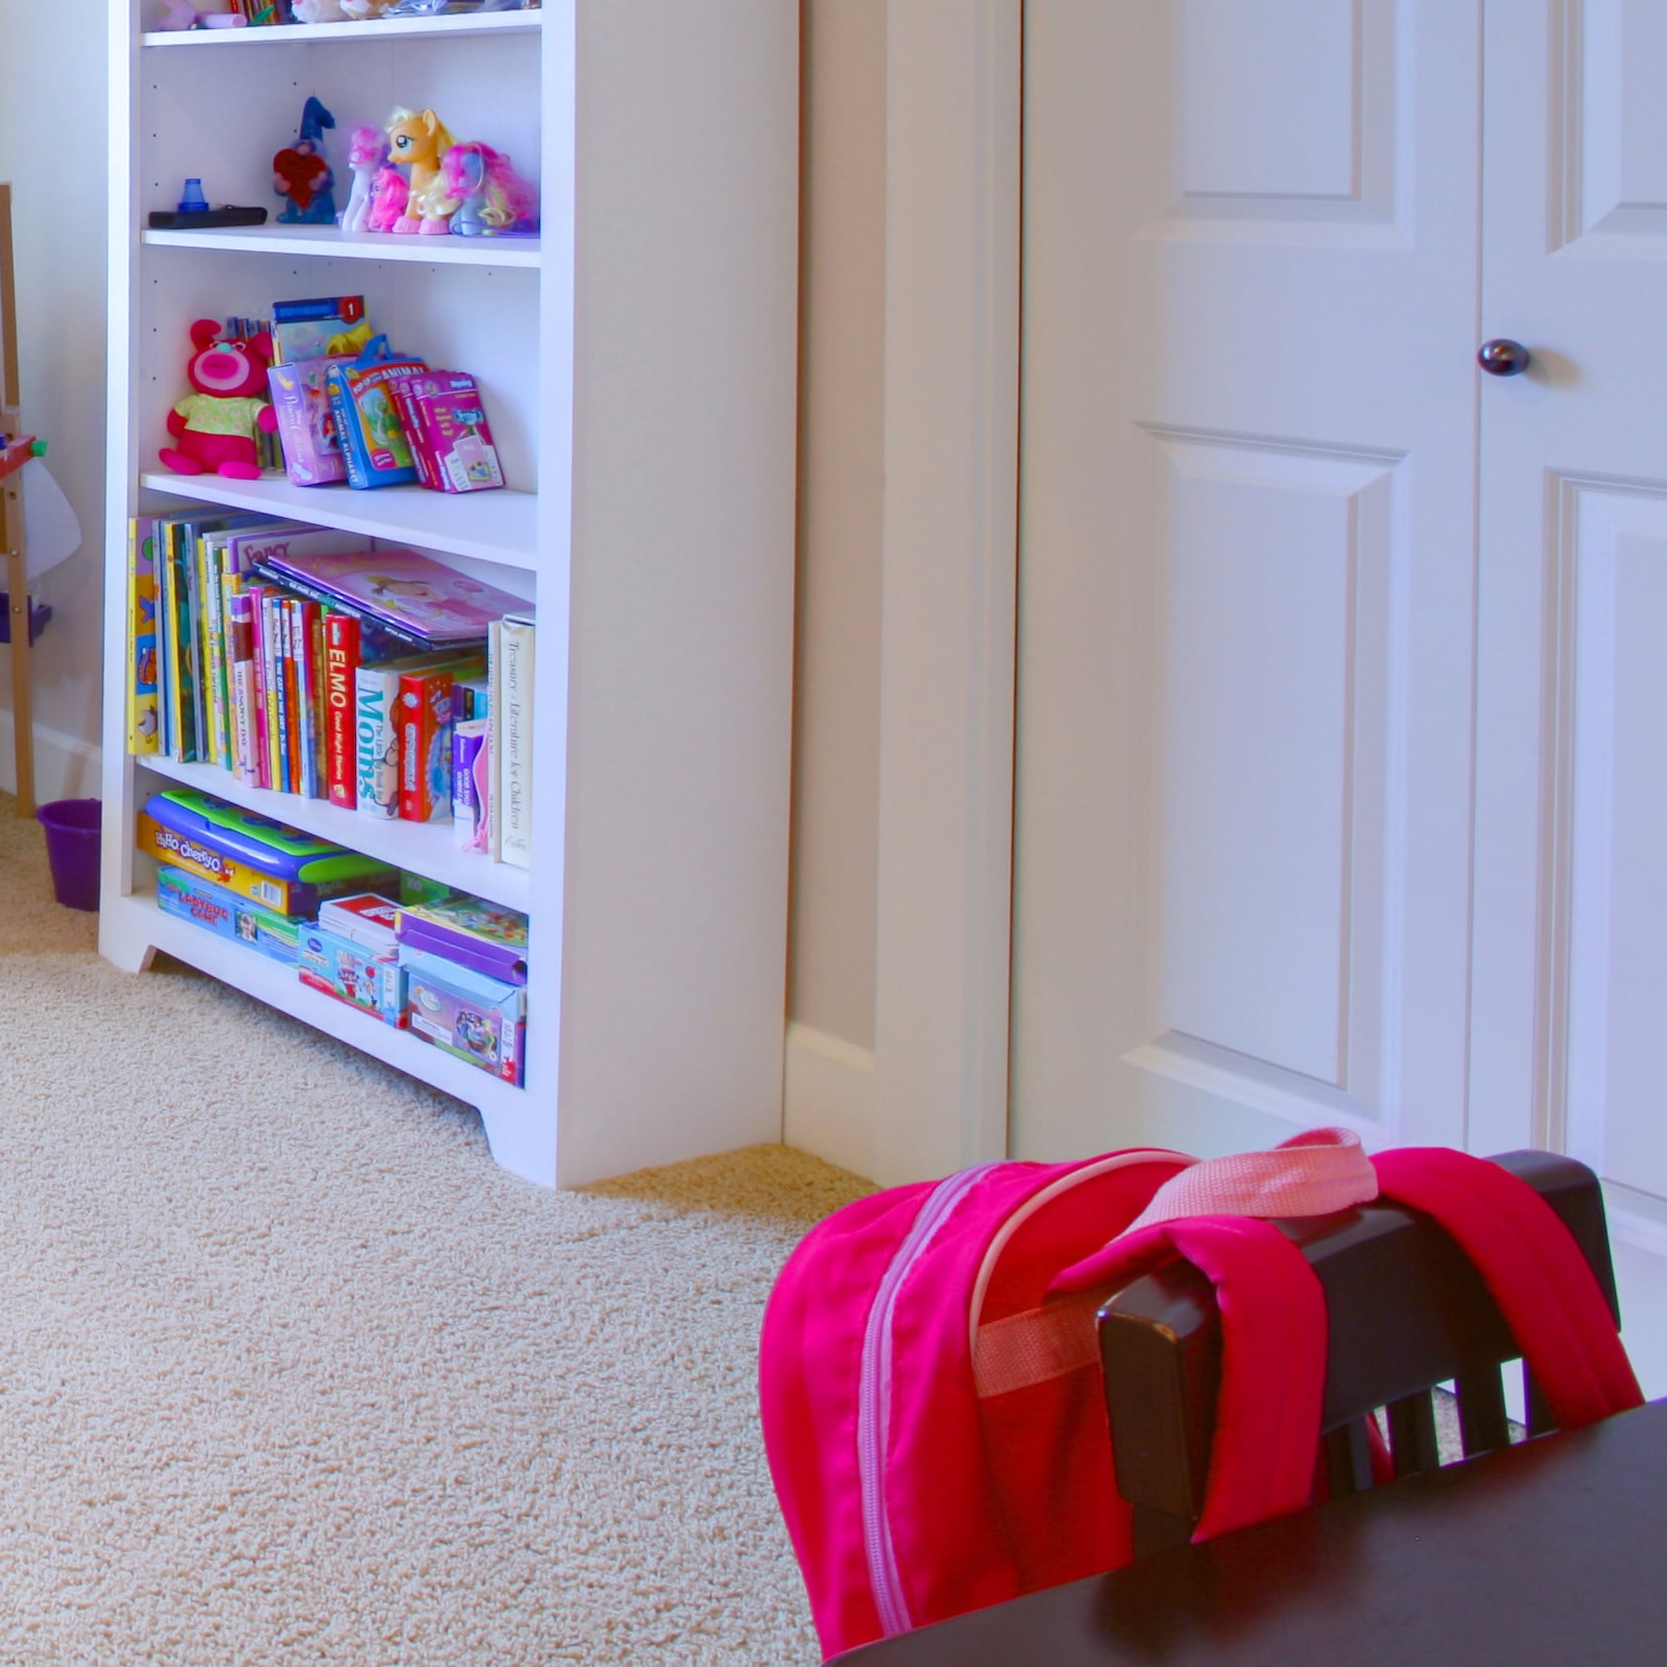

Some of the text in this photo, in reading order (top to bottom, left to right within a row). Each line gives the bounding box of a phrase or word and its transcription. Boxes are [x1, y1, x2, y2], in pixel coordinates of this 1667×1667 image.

[348, 302, 354, 316] 1
[508, 641, 520, 691] Treasury
[238, 689, 247, 726] SNOWY
[329, 649, 346, 780] ELMO Good Night Stories
[376, 725, 384, 737] The
[510, 702, 521, 758] Literature
[358, 687, 384, 800] Moms
[510, 781, 522, 829] Children
